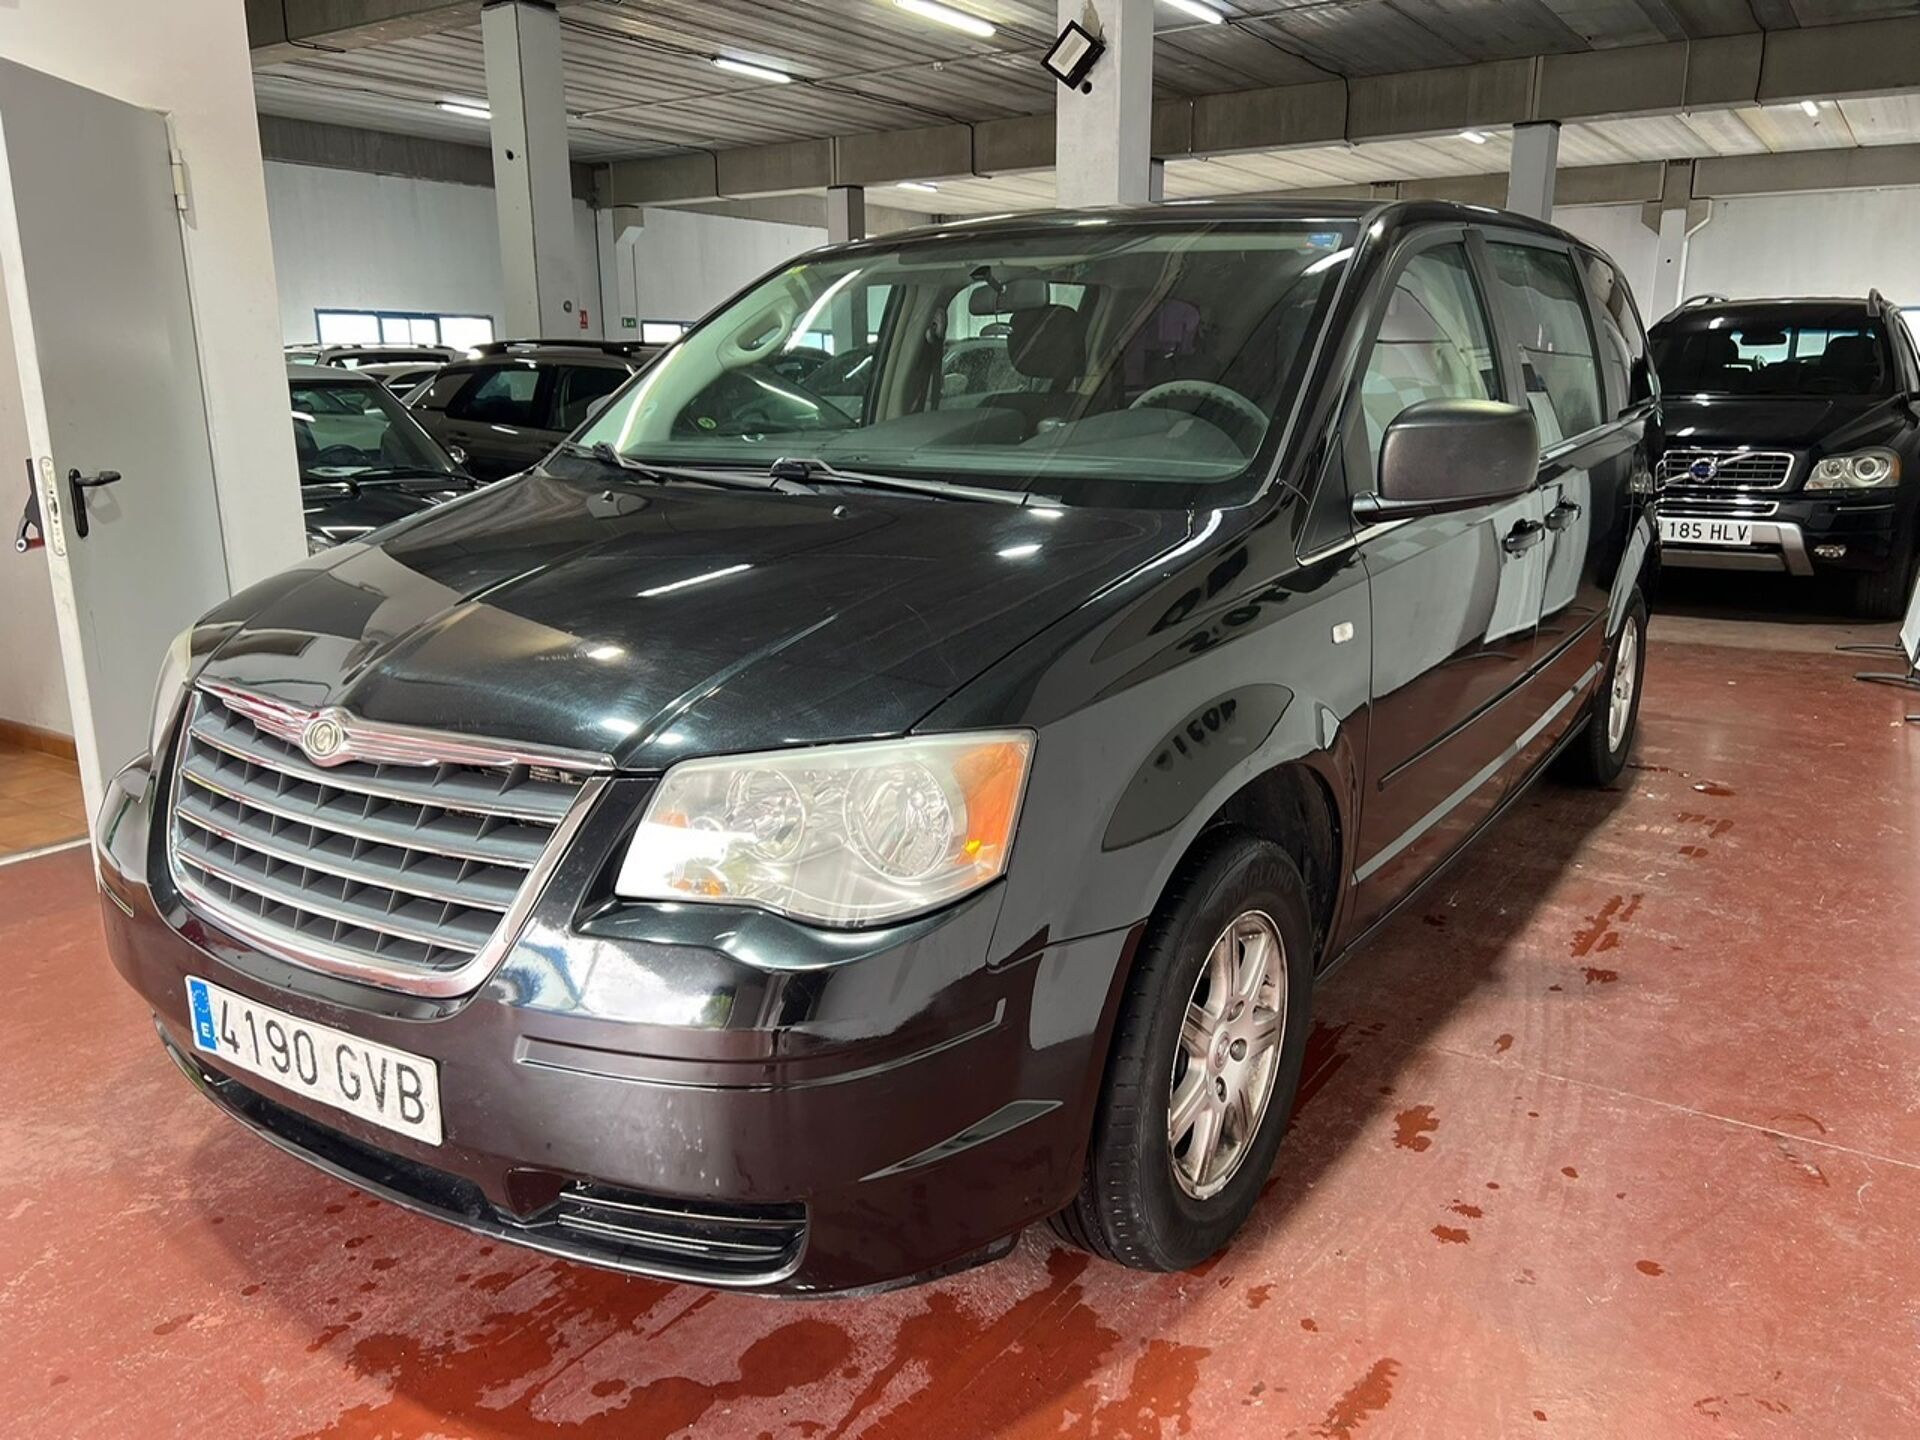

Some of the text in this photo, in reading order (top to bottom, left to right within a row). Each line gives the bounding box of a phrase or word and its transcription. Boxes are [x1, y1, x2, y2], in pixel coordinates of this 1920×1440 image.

[1660, 522, 1748, 541] 185 HLV
[201, 1022, 211, 1038] E
[220, 1000, 425, 1125] 4190 GVB
